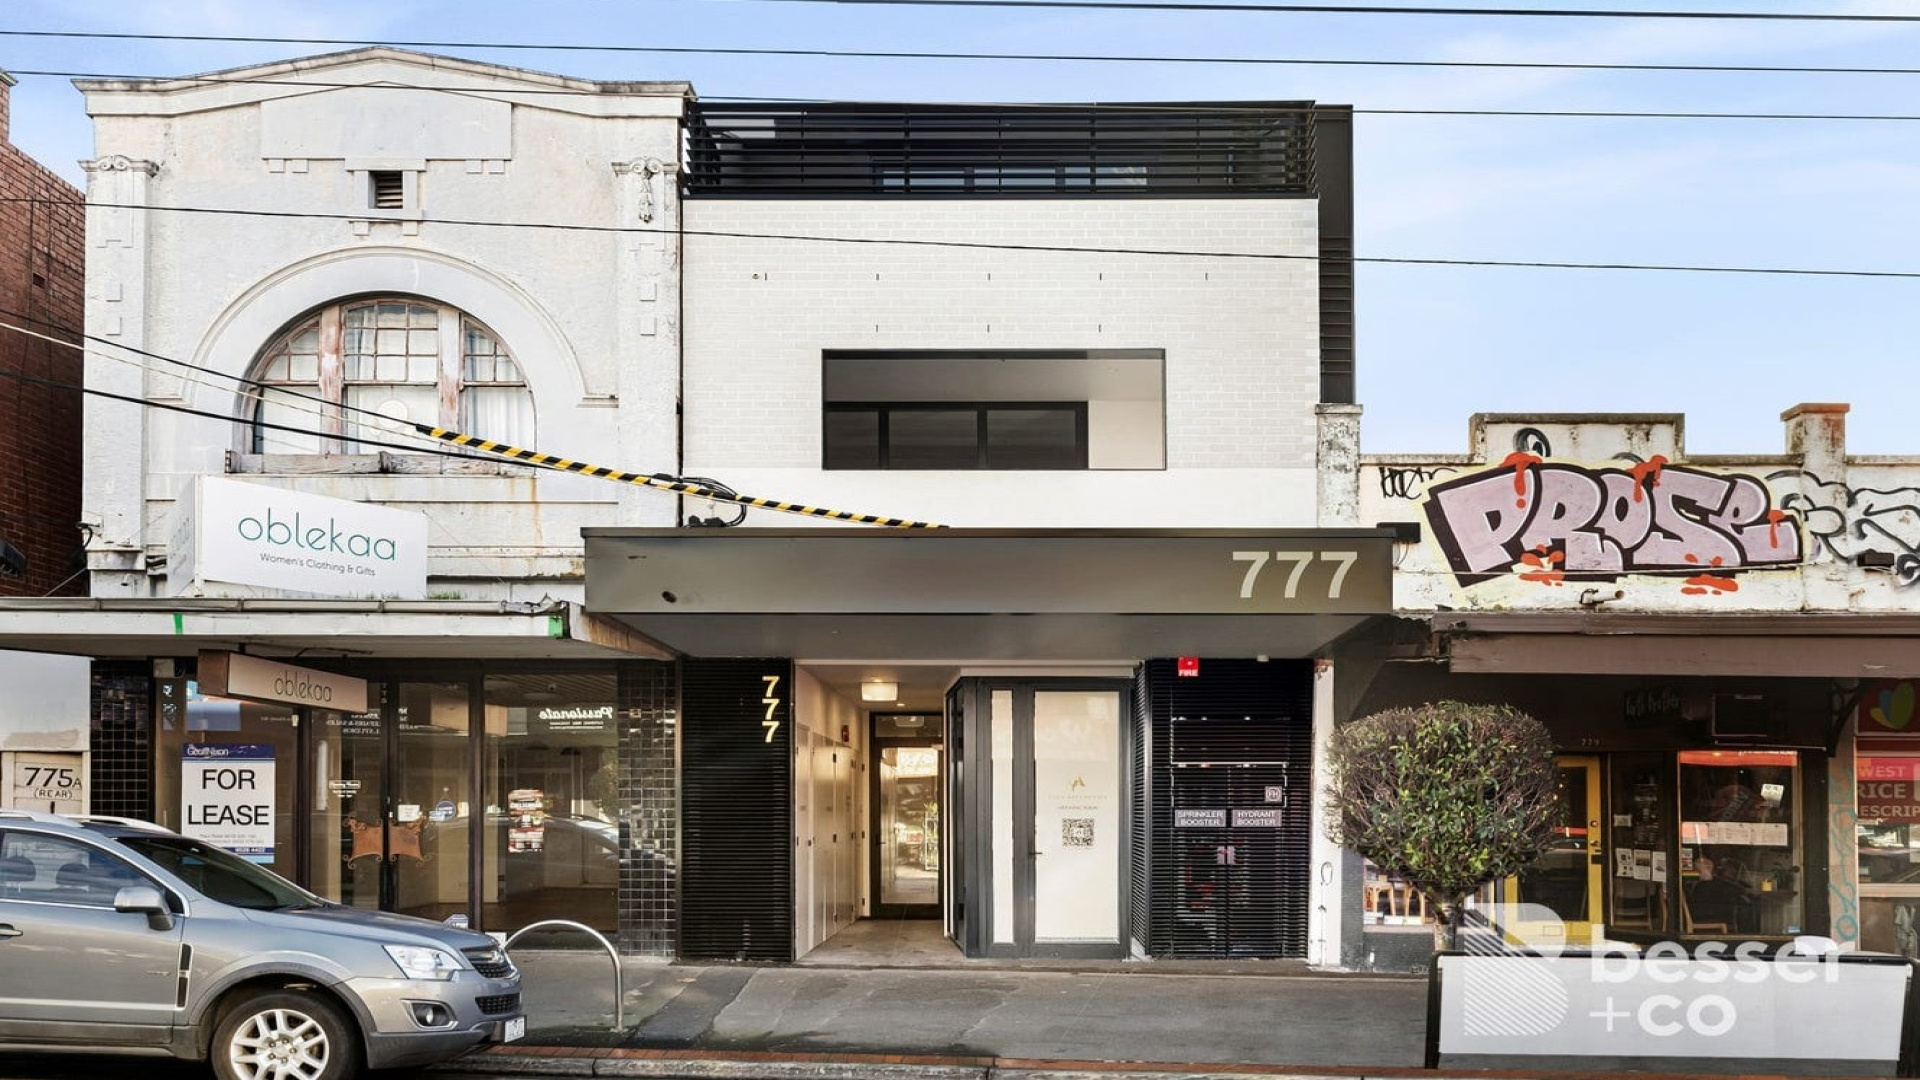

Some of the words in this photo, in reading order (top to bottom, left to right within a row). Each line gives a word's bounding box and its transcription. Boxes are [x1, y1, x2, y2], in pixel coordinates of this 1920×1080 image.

[238, 507, 395, 561] oblekaa
[259, 552, 304, 567] Women's
[306, 559, 345, 574] Clothing
[346, 565, 354, 573] &
[356, 565, 376, 577] Gifts
[1233, 551, 1358, 598] 777
[274, 669, 333, 702] oblekaa
[762, 676, 780, 742] 777
[34, 788, 73, 800] (REAR)
[202, 769, 255, 790] FOR
[188, 804, 270, 826] LEASE
